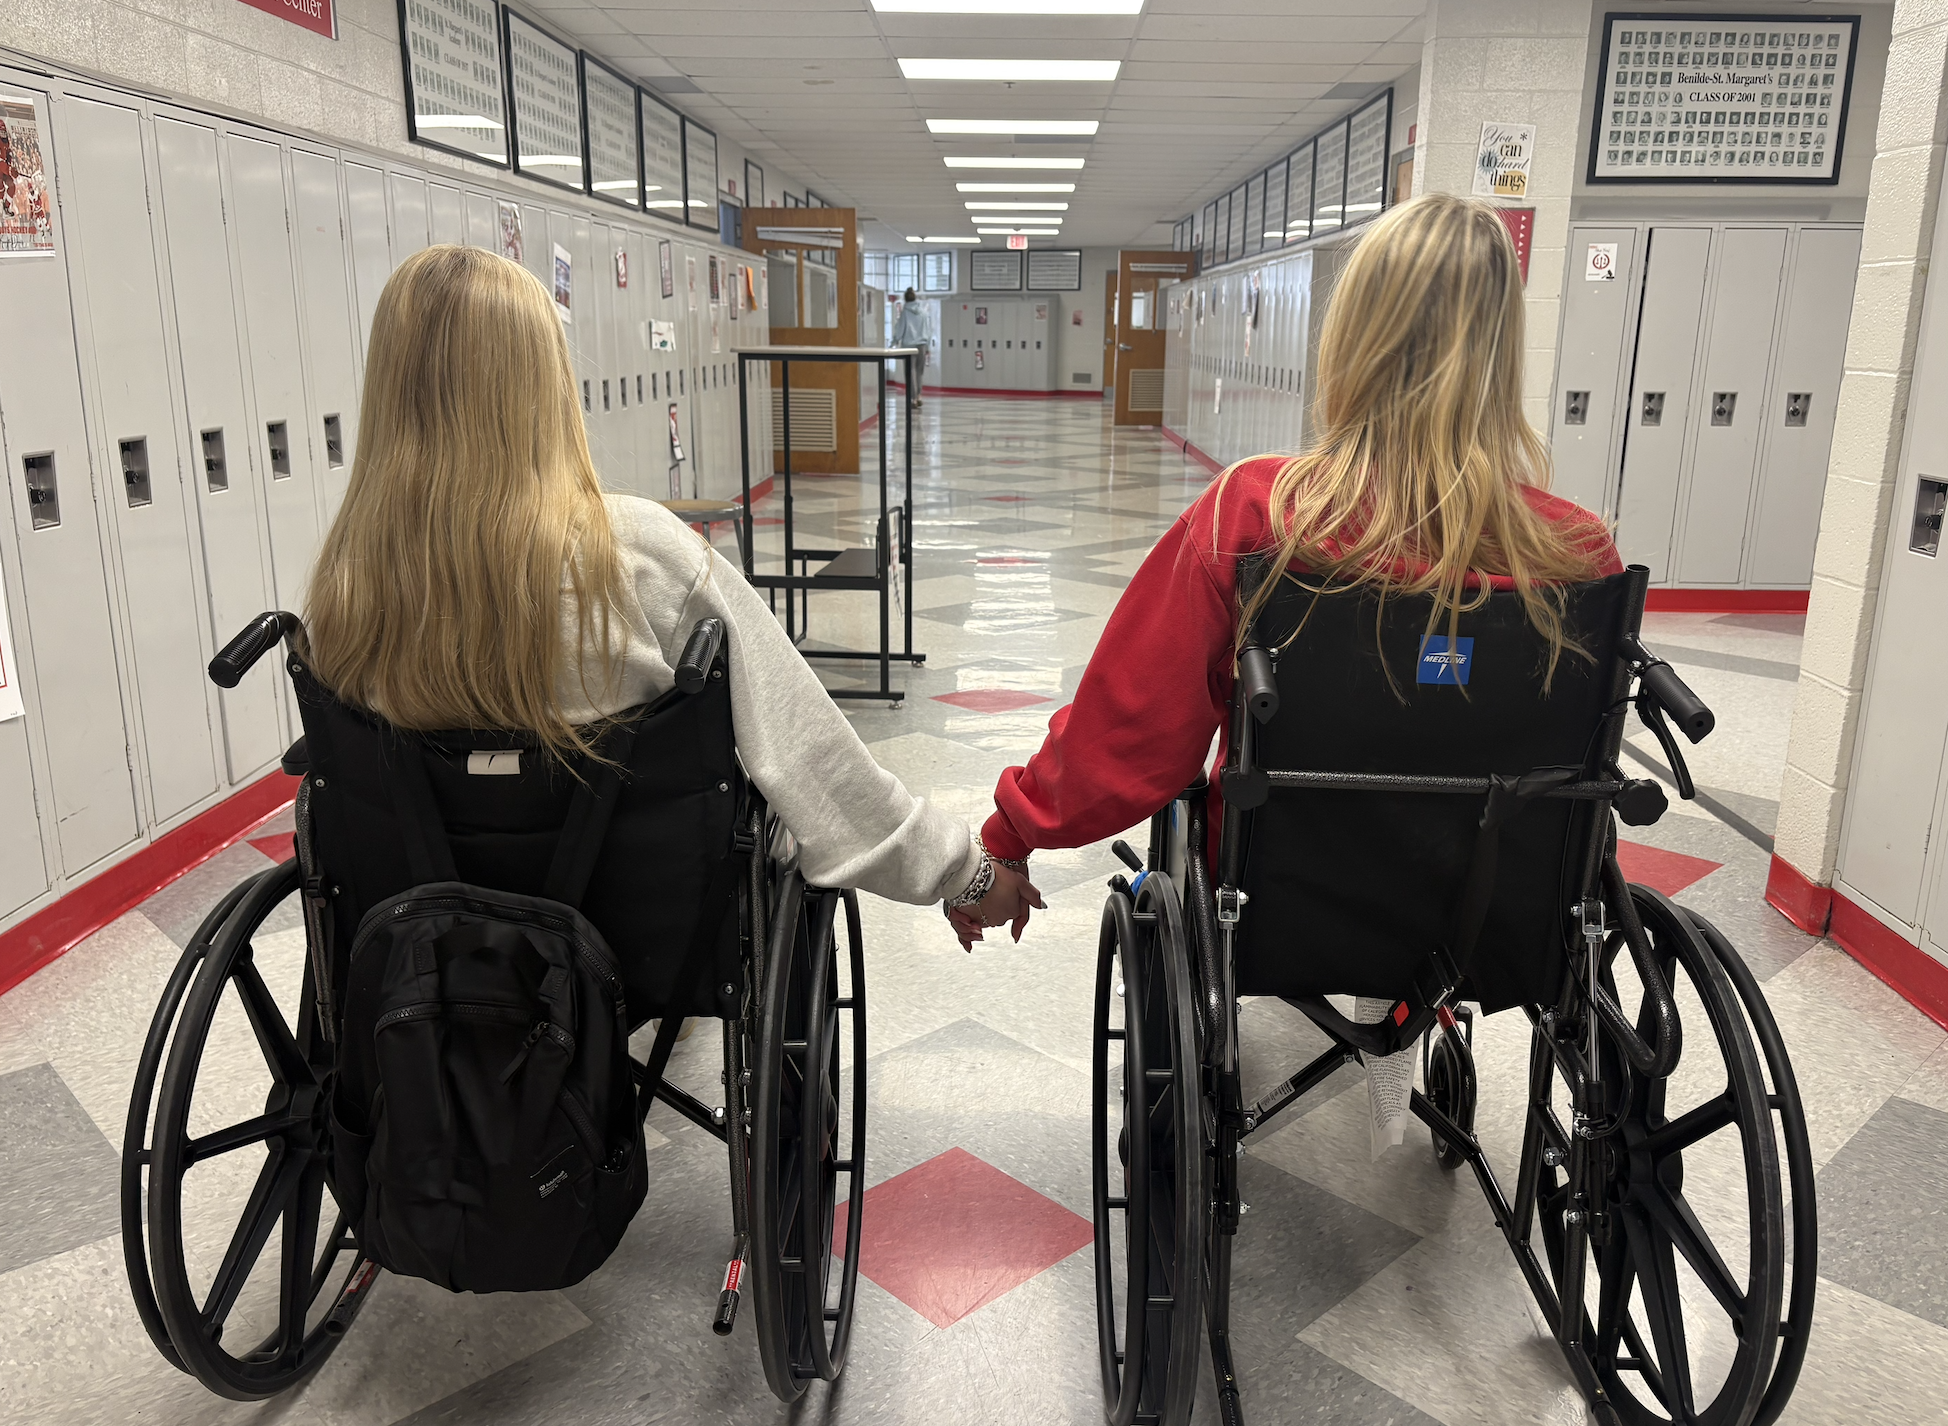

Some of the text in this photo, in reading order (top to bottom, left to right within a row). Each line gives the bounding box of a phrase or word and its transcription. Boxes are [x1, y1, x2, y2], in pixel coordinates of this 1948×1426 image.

[1677, 72, 1774, 87] Benilde-St. Margaret's
[1689, 92, 1756, 102] CLASS OF 2001
[1483, 125, 1513, 148] You
[1500, 144, 1522, 157] can
[1482, 150, 1530, 170] do hard
[1490, 169, 1526, 192] things
